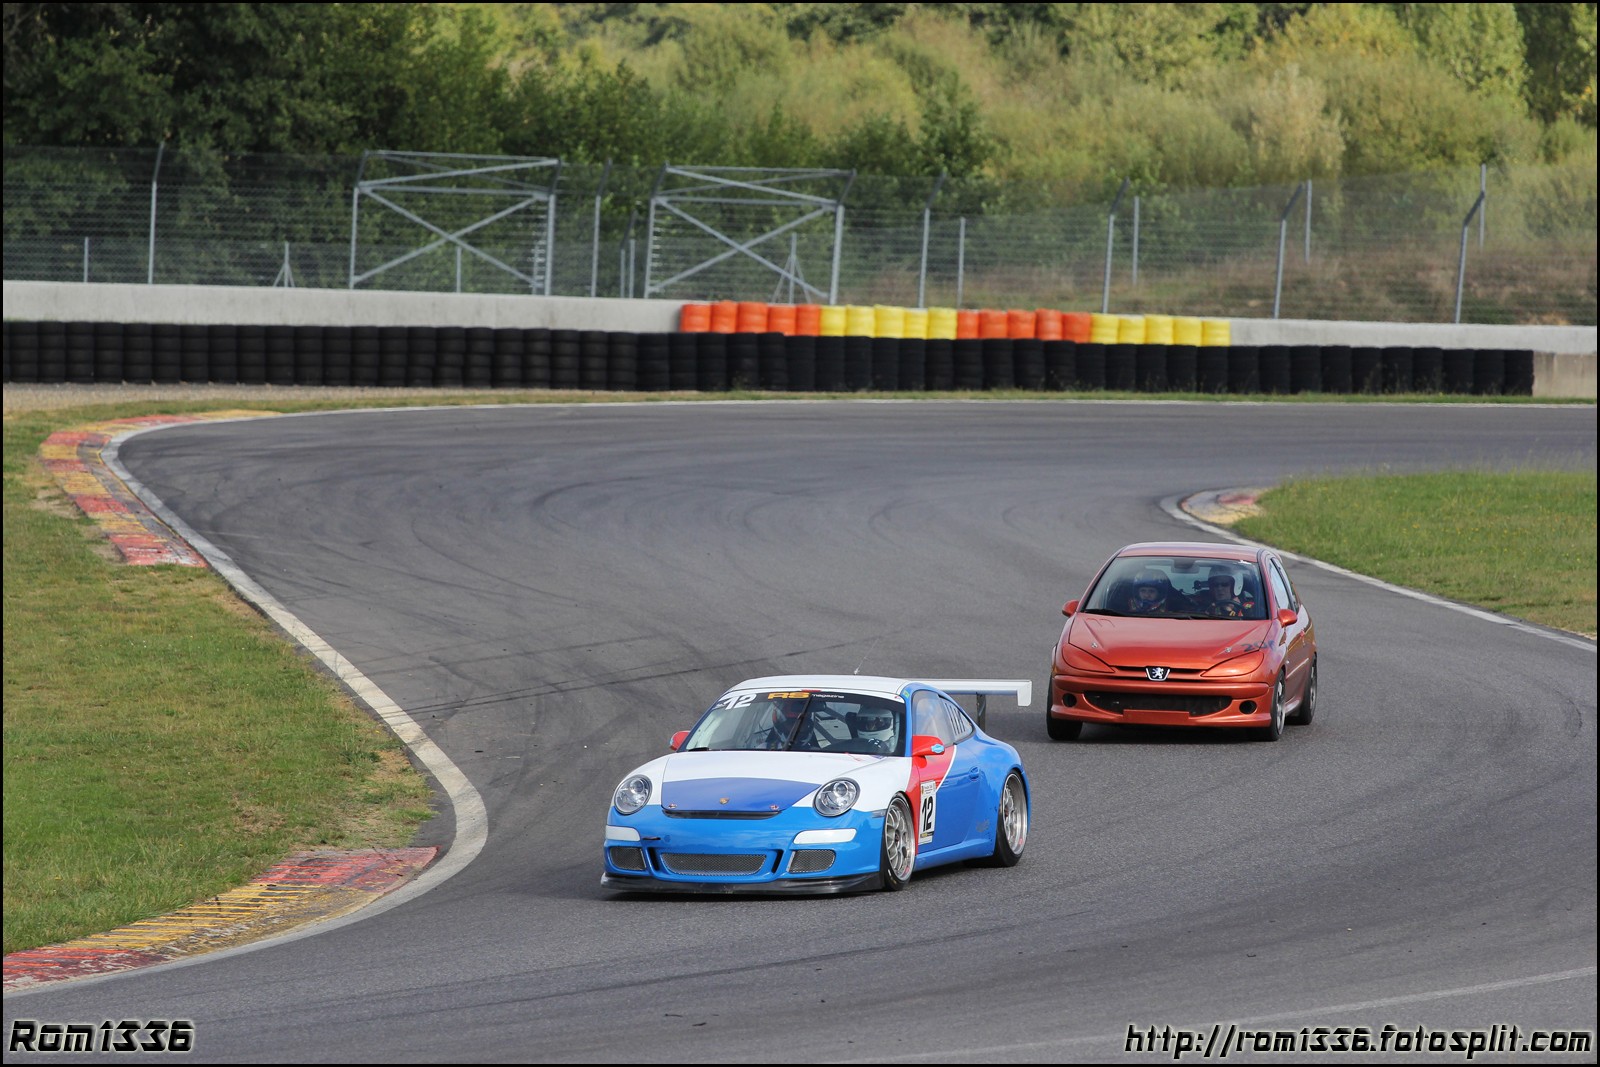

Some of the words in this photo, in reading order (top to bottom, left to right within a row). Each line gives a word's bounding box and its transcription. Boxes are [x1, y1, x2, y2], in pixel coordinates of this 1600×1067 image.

[722, 693, 757, 710] 12
[767, 692, 810, 700] RS
[922, 796, 933, 832] 12
